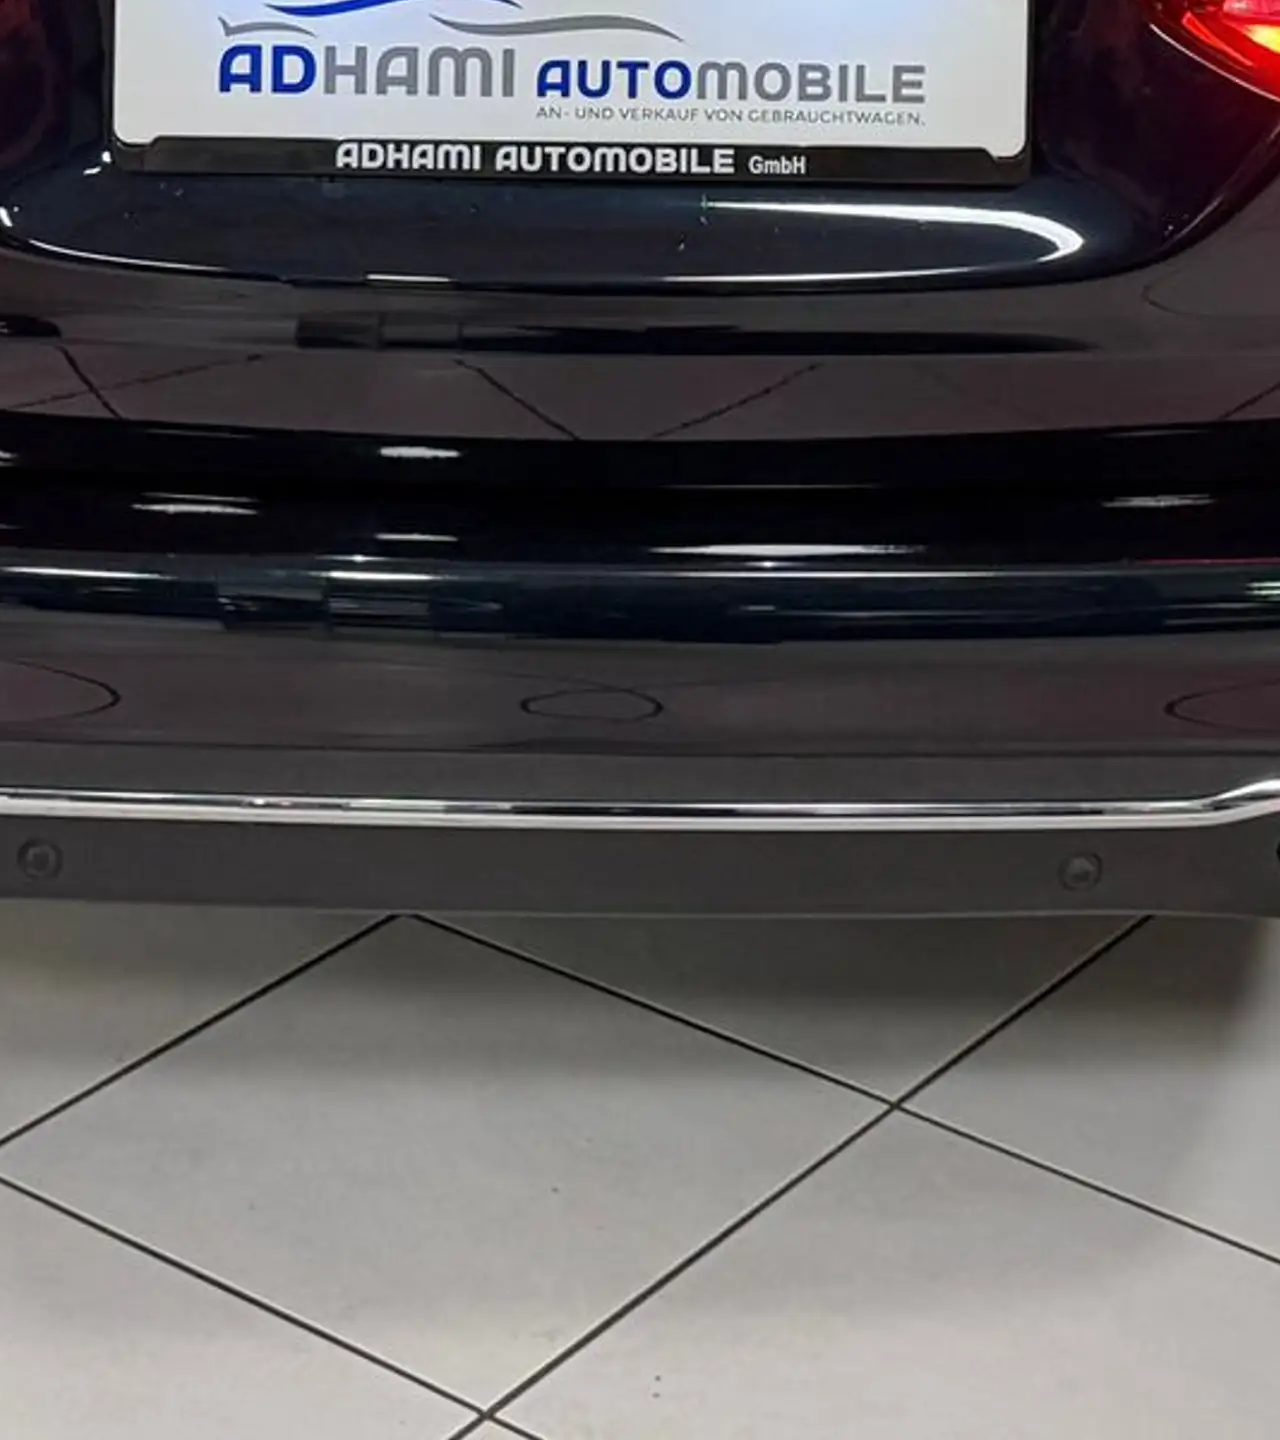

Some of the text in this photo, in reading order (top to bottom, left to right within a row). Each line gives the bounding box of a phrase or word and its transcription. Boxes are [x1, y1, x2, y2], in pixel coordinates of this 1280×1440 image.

[219, 44, 927, 105] ADHAMI AUTOMOBILE
[536, 106, 570, 120] AN-
[575, 106, 616, 121] UND
[619, 107, 700, 123] VERKAUF
[704, 108, 744, 123] VON
[335, 142, 807, 176] ADHAMI AUTOMOBILE GmbH
